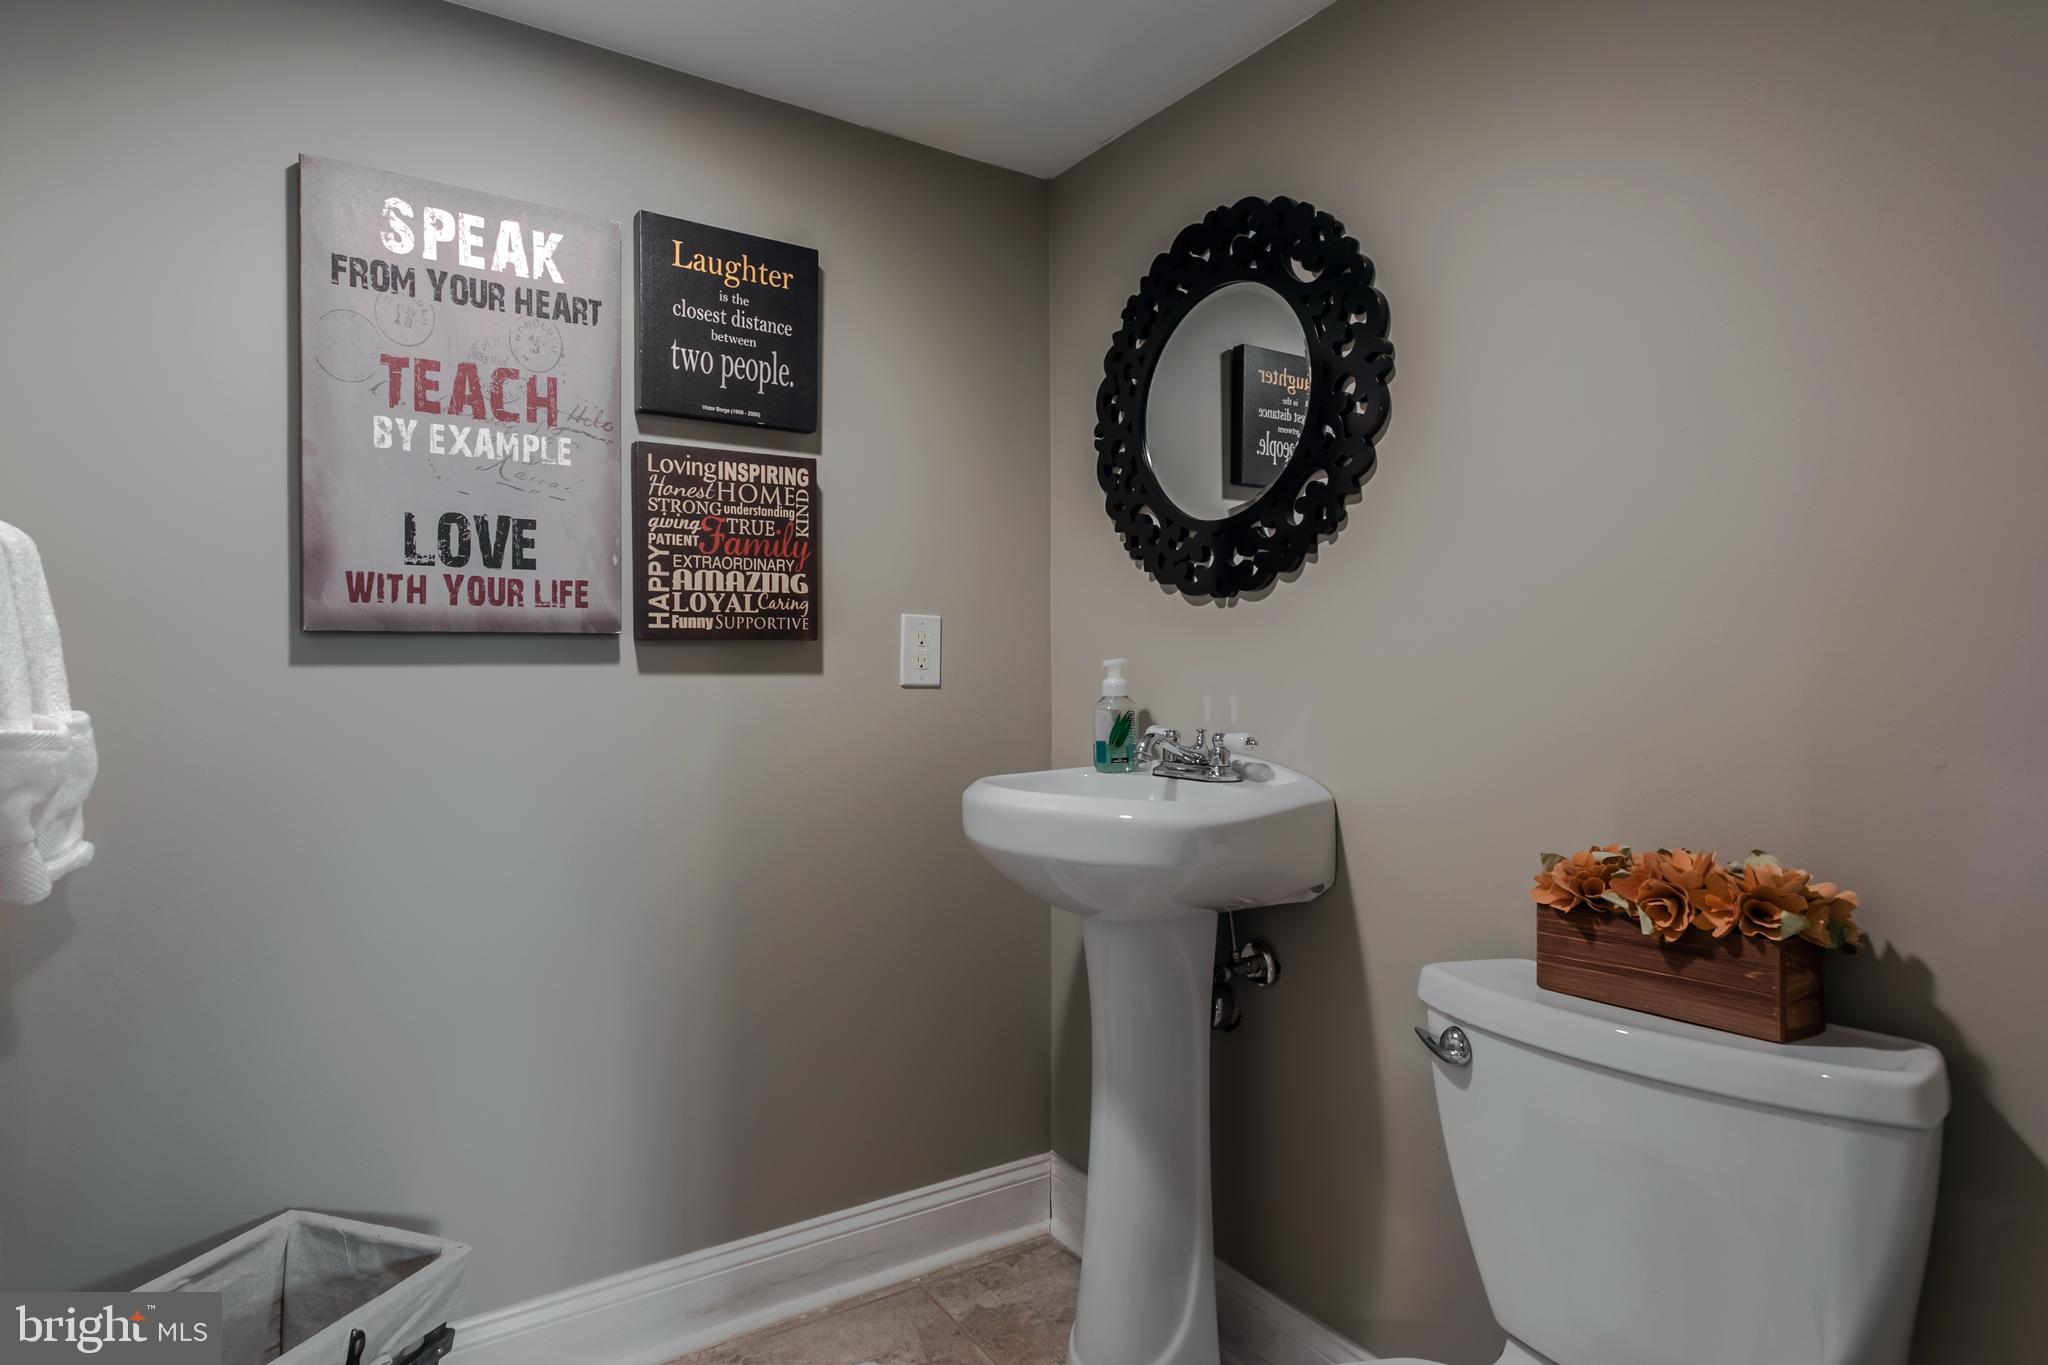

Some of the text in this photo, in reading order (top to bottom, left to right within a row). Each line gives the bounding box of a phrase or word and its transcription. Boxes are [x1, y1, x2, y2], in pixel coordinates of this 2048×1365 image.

[380, 197, 565, 284] SPEAK
[671, 239, 794, 290] Laughter
[331, 253, 416, 298] FROM
[426, 268, 506, 312] YOUR
[515, 286, 602, 327] HEART
[719, 290, 750, 307] is the
[672, 299, 793, 336] closest distance
[711, 329, 757, 347] between
[670, 339, 794, 395] two people.
[380, 353, 557, 427] TEACH
[373, 415, 572, 466] BY EXAMPLE
[647, 453, 809, 487] Loving INSPIRING
[648, 474, 795, 506] Honest HOME
[648, 497, 795, 521] STRONG understanding
[648, 512, 775, 536] giving TRUE
[795, 489, 809, 538] KIND
[404, 512, 537, 570] LOVE
[648, 532, 700, 547] PATIENT
[699, 515, 811, 573] Family
[671, 568, 809, 594] AMAZING
[673, 554, 795, 573] EXTRAORDINARY
[345, 571, 588, 608] WITH YOUR LIFE
[648, 544, 670, 629] HAPPY
[671, 592, 809, 617] LOYAL Caring
[671, 614, 809, 631] Funny SUPPORTIVE
